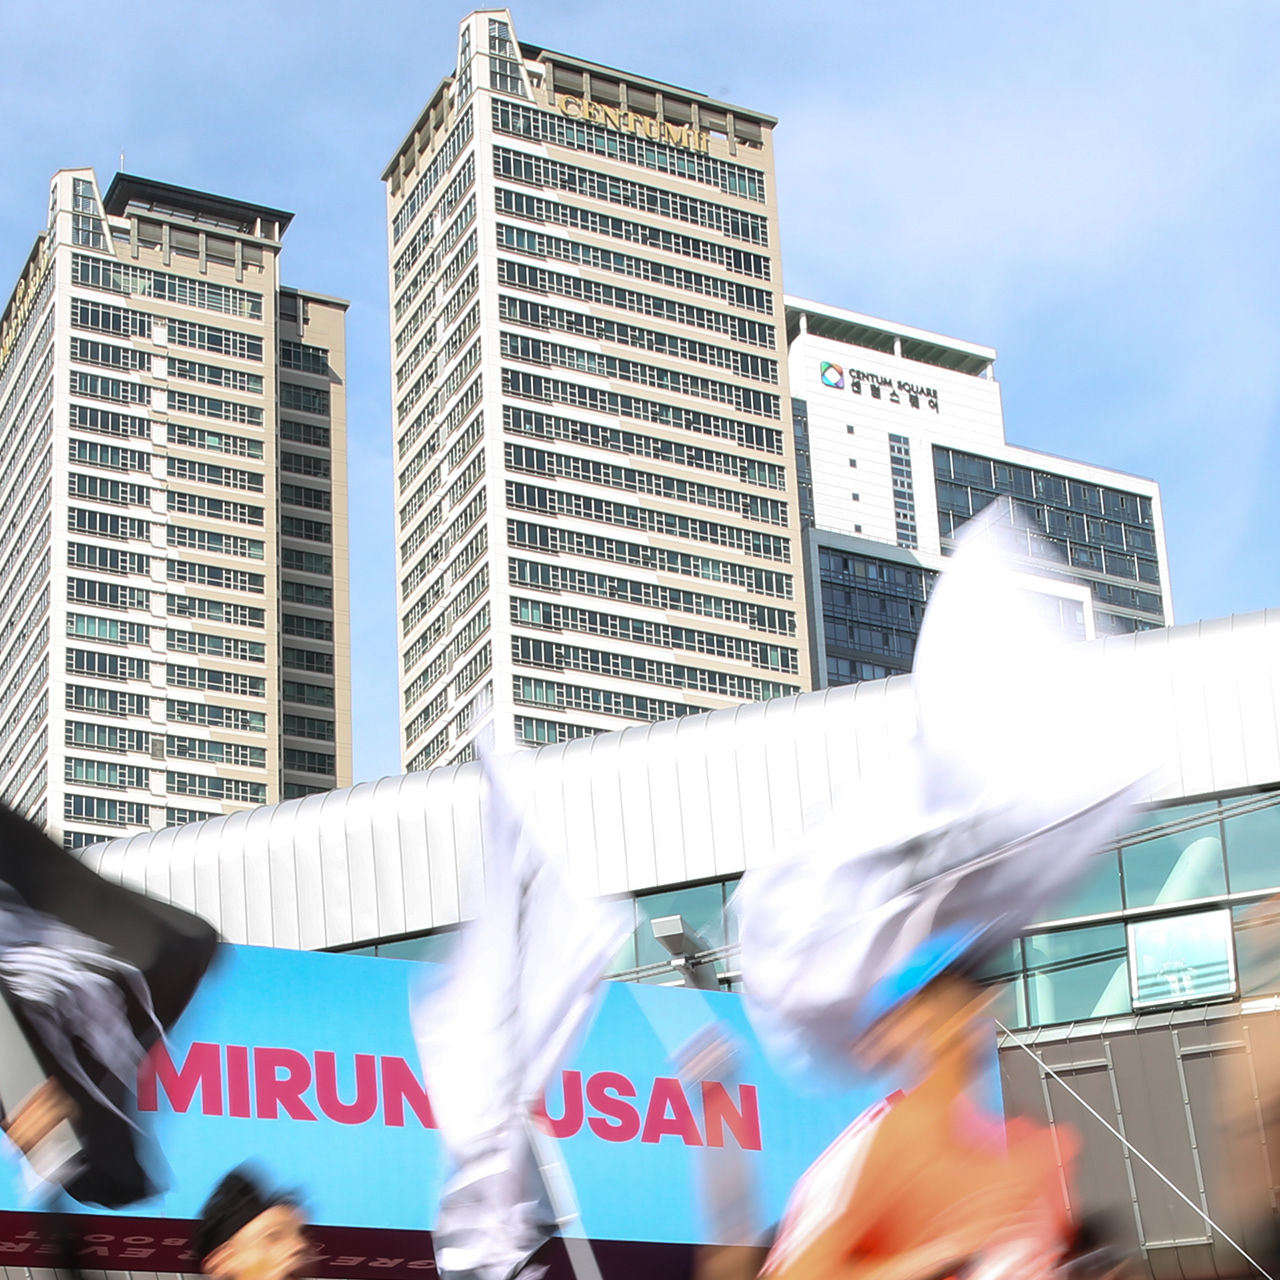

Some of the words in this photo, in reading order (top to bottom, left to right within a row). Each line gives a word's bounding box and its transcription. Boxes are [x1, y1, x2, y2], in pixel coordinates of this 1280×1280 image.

[849, 368, 893, 388] CENTUM
[897, 380, 938, 399] SQUARE
[530, 1070, 762, 1151] USAN
